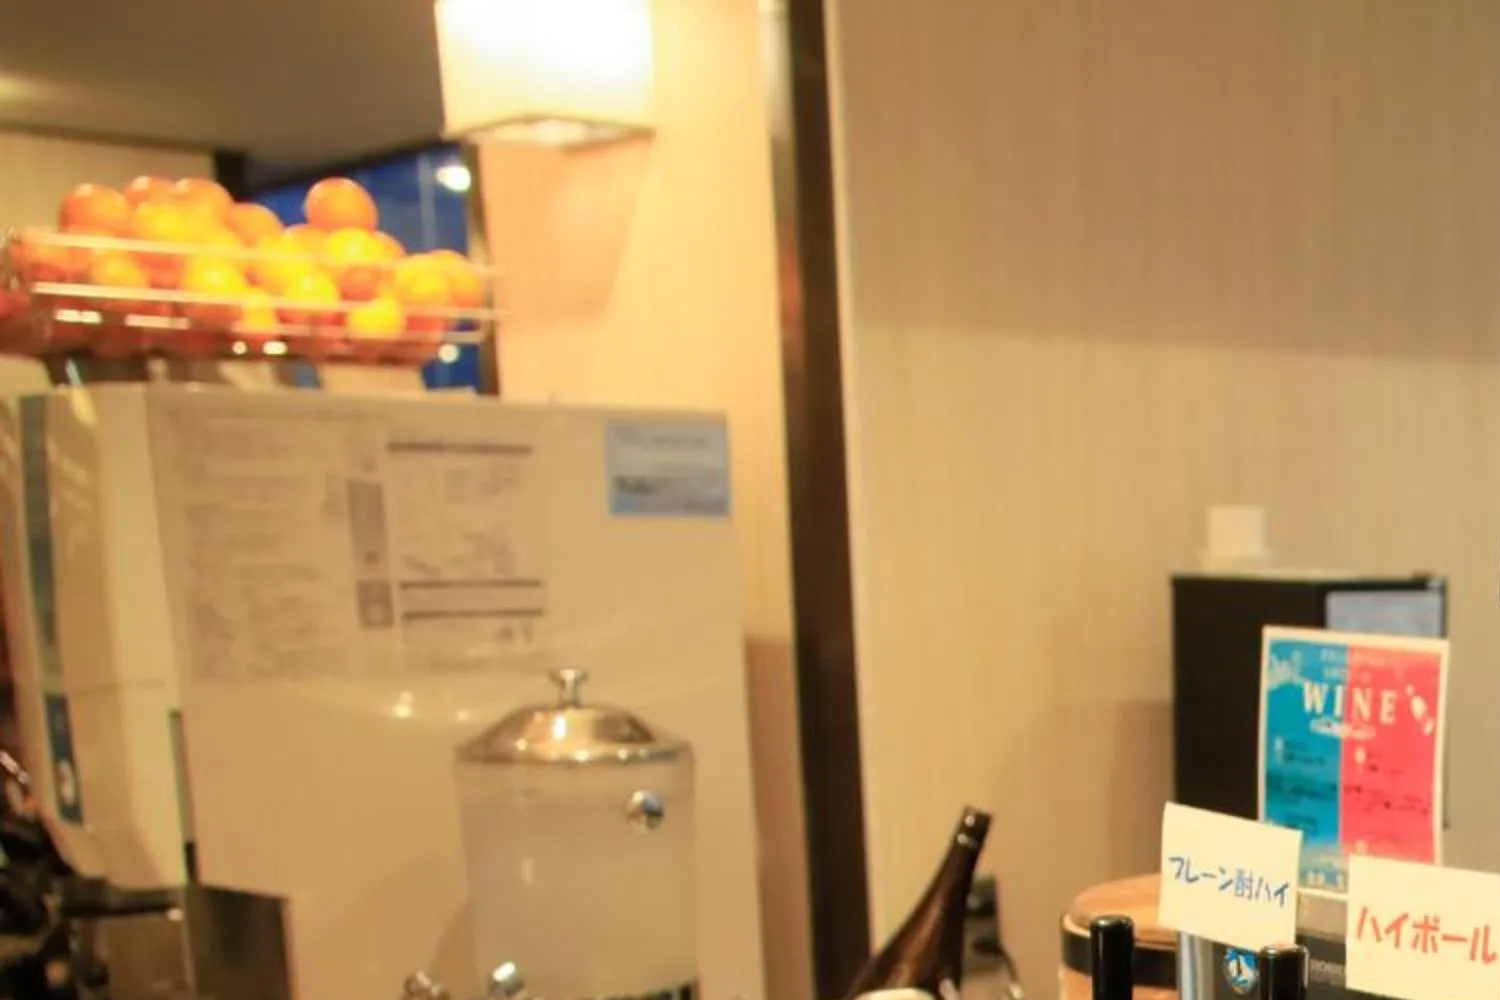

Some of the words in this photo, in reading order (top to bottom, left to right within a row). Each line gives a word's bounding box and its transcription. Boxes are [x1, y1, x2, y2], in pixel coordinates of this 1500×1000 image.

[1301, 680, 1399, 727] WINE
[1355, 905, 1498, 966] ハイボール
